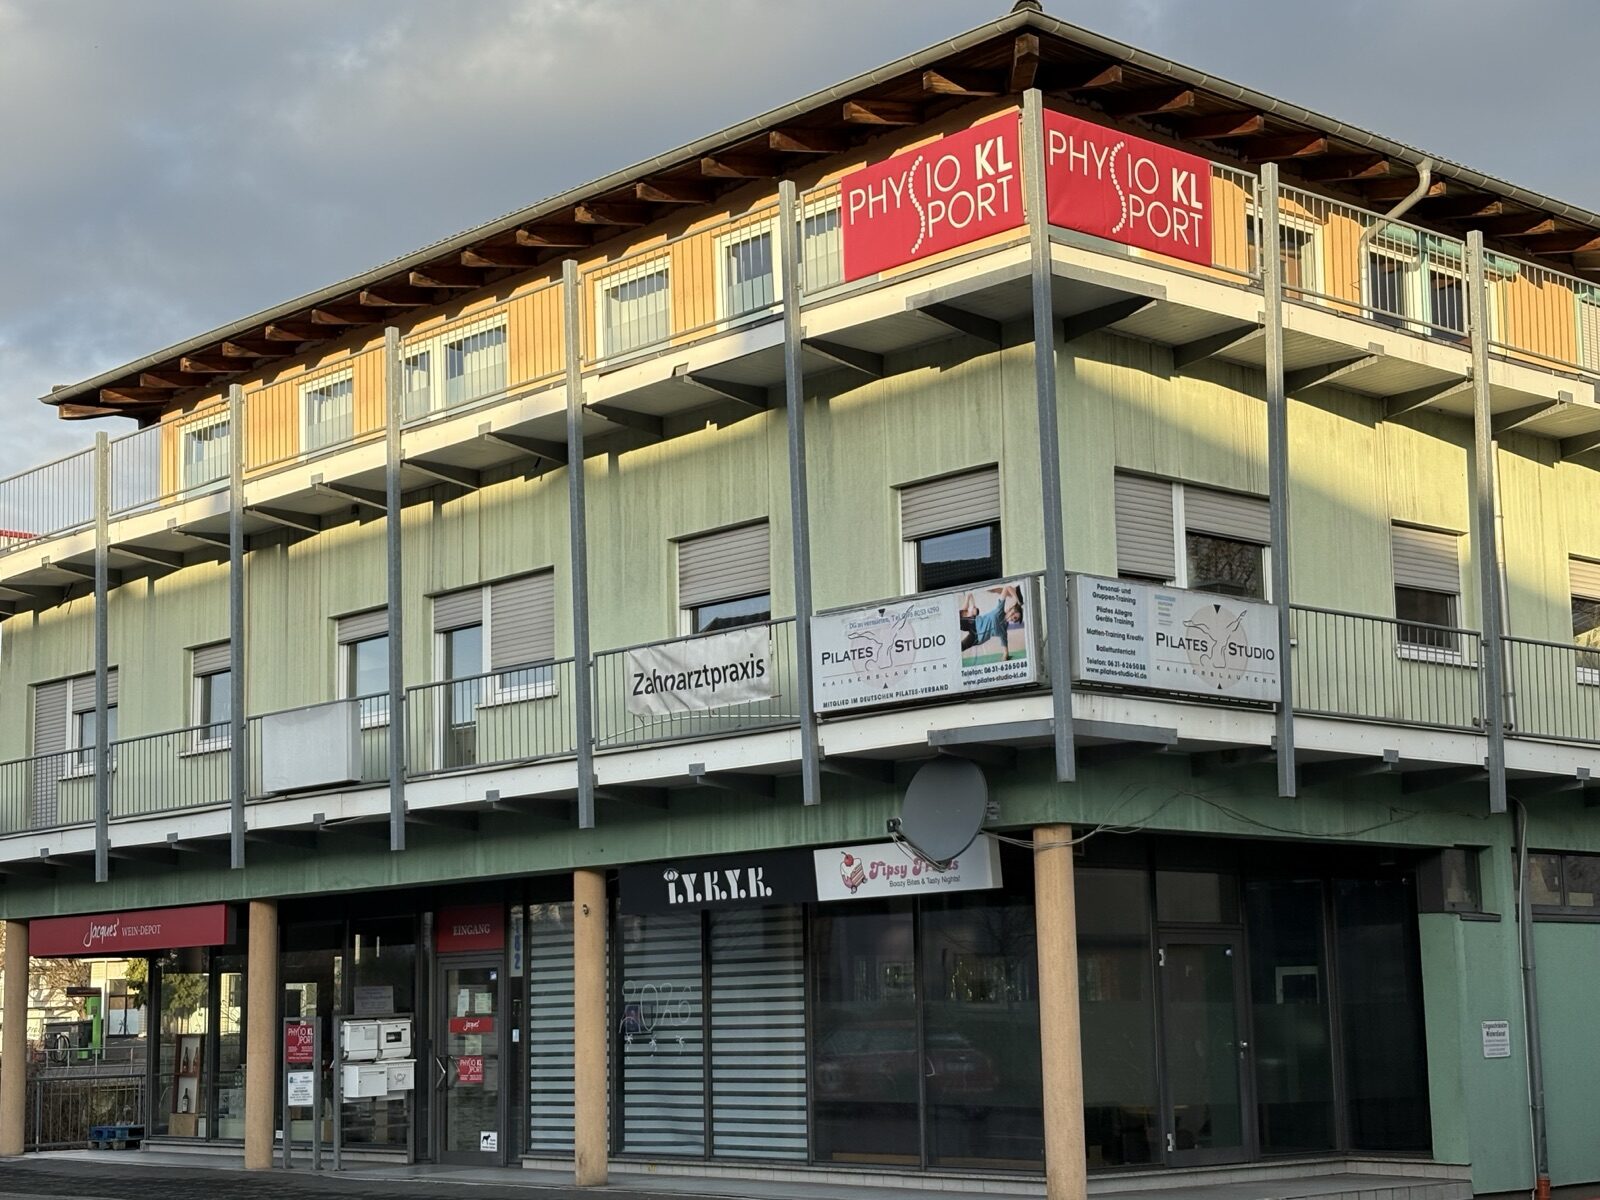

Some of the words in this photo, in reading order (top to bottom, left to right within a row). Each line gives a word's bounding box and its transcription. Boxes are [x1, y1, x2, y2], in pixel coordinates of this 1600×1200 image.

[1049, 130, 1159, 234] PHYSIO
[1172, 168, 1203, 210] KL
[849, 155, 961, 254] PHYSIO
[975, 136, 1013, 181] KL
[1096, 605, 1114, 614] Pilates
[1114, 617, 1135, 628] Training
[821, 646, 873, 666] PILATES
[894, 634, 946, 653] STUDIO
[1155, 631, 1208, 653] PILATES
[1228, 641, 1275, 661] STUDIO
[1086, 657, 1106, 666] Telefon:
[632, 652, 766, 697] Zahnarztpraxis
[961, 668, 984, 677] Telefon:
[822, 698, 849, 709] MITGLIED
[850, 696, 859, 704] IM
[859, 693, 894, 704] DEUTSCHEN
[895, 683, 949, 698] PILATES-VERBAND
[868, 860, 908, 880] Tipsy
[121, 924, 162, 937] WEIN-DEPOT
[453, 923, 491, 937] EINGANG
